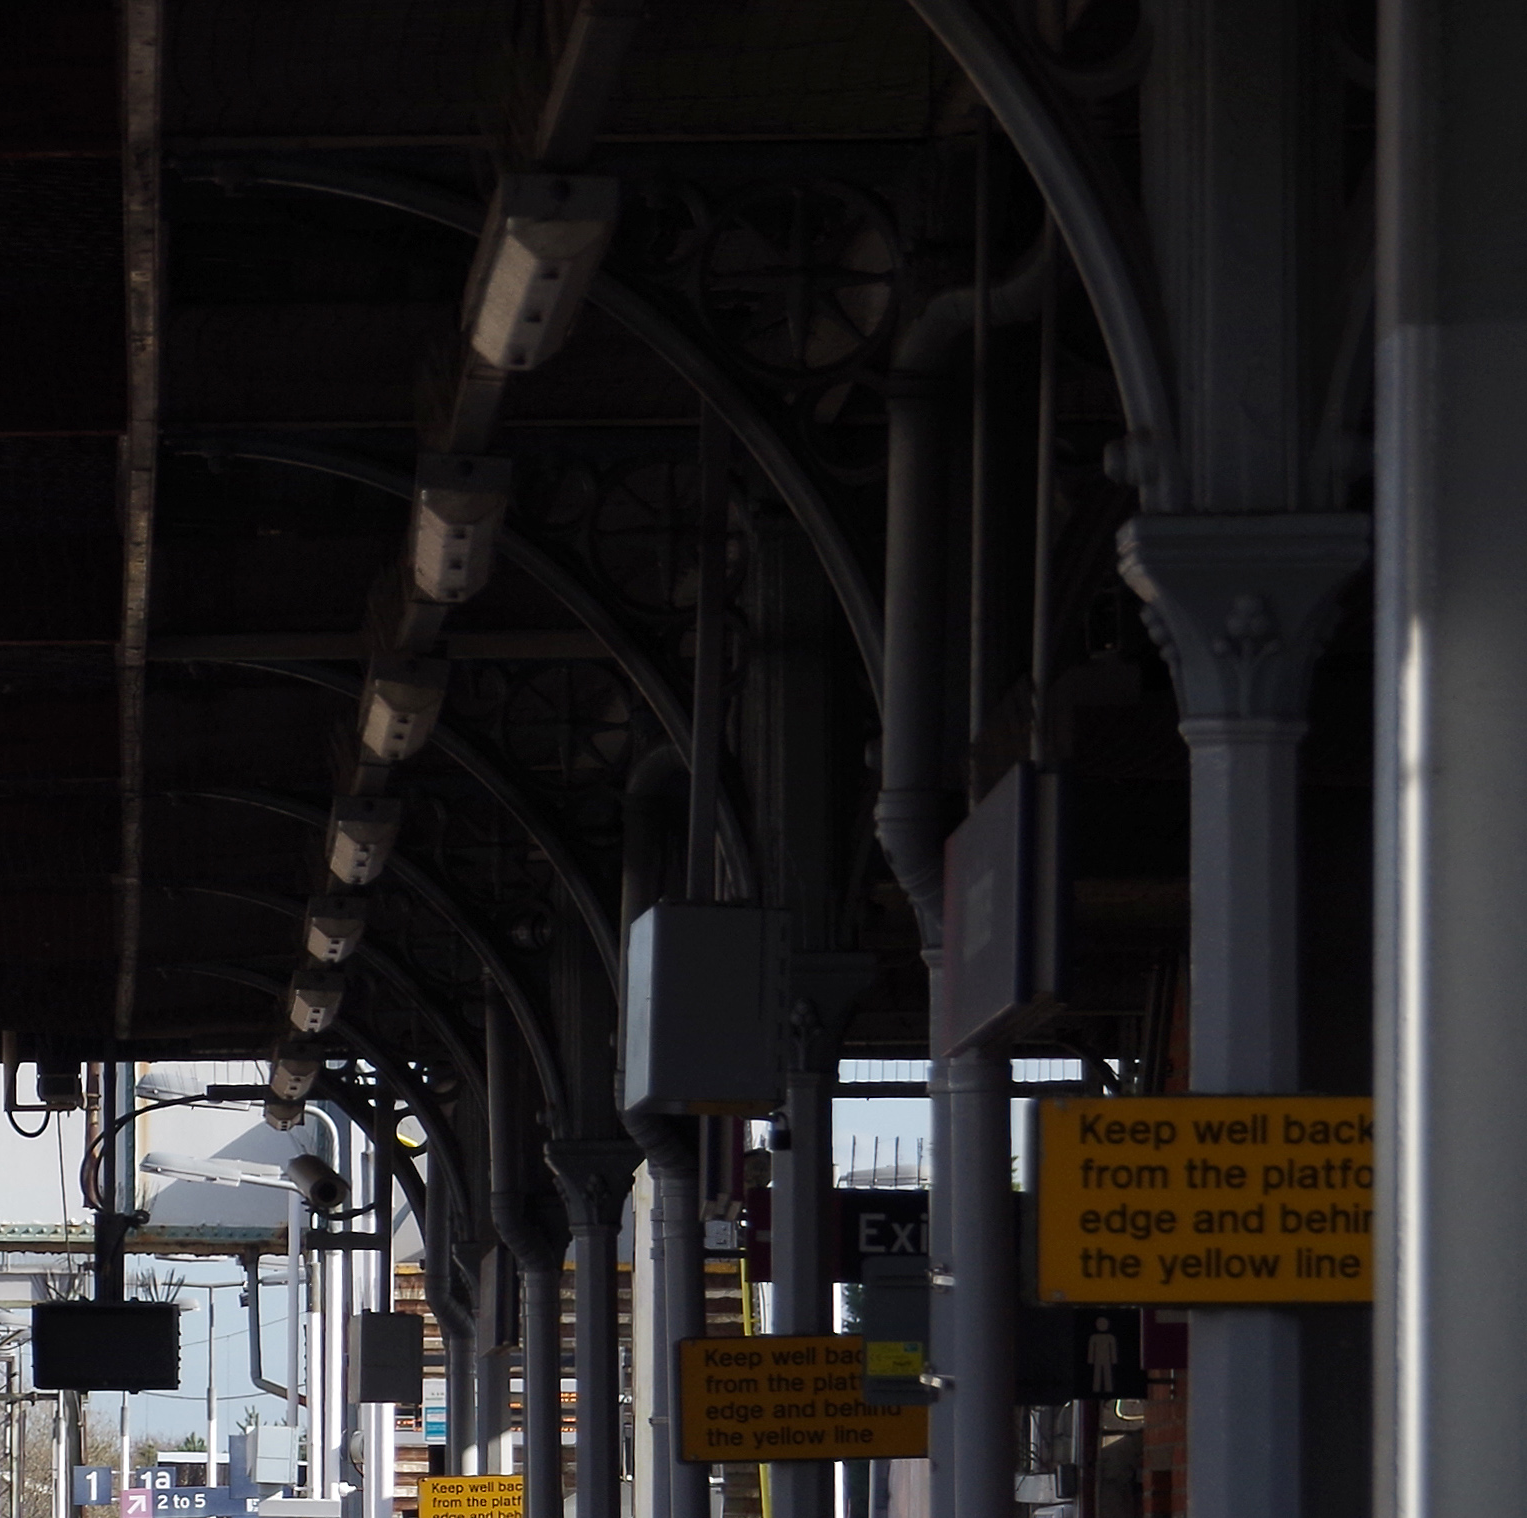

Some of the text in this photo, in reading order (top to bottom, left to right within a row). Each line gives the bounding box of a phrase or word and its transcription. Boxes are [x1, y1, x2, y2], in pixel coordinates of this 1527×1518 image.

[1080, 1113, 1373, 1150] Keep well back
[1081, 1158, 1373, 1195] from the platfo
[858, 1212, 928, 1253] Exi
[1081, 1204, 1177, 1240] edge
[1193, 1204, 1264, 1234] and
[1081, 1248, 1361, 1284] the yellow line
[704, 1349, 763, 1371] Keep
[772, 1347, 817, 1367] well
[825, 1347, 864, 1365] bac
[705, 1375, 766, 1394] from
[768, 1373, 808, 1393] the
[705, 1400, 764, 1422] edge
[773, 1398, 816, 1418] and
[706, 1425, 874, 1449] the yellow line
[85, 1471, 97, 1501] 1
[140, 1471, 171, 1489] 1a
[431, 1481, 523, 1495] Keep well bac
[156, 1494, 206, 1510] 2 to 5
[432, 1496, 523, 1509] from the platf
